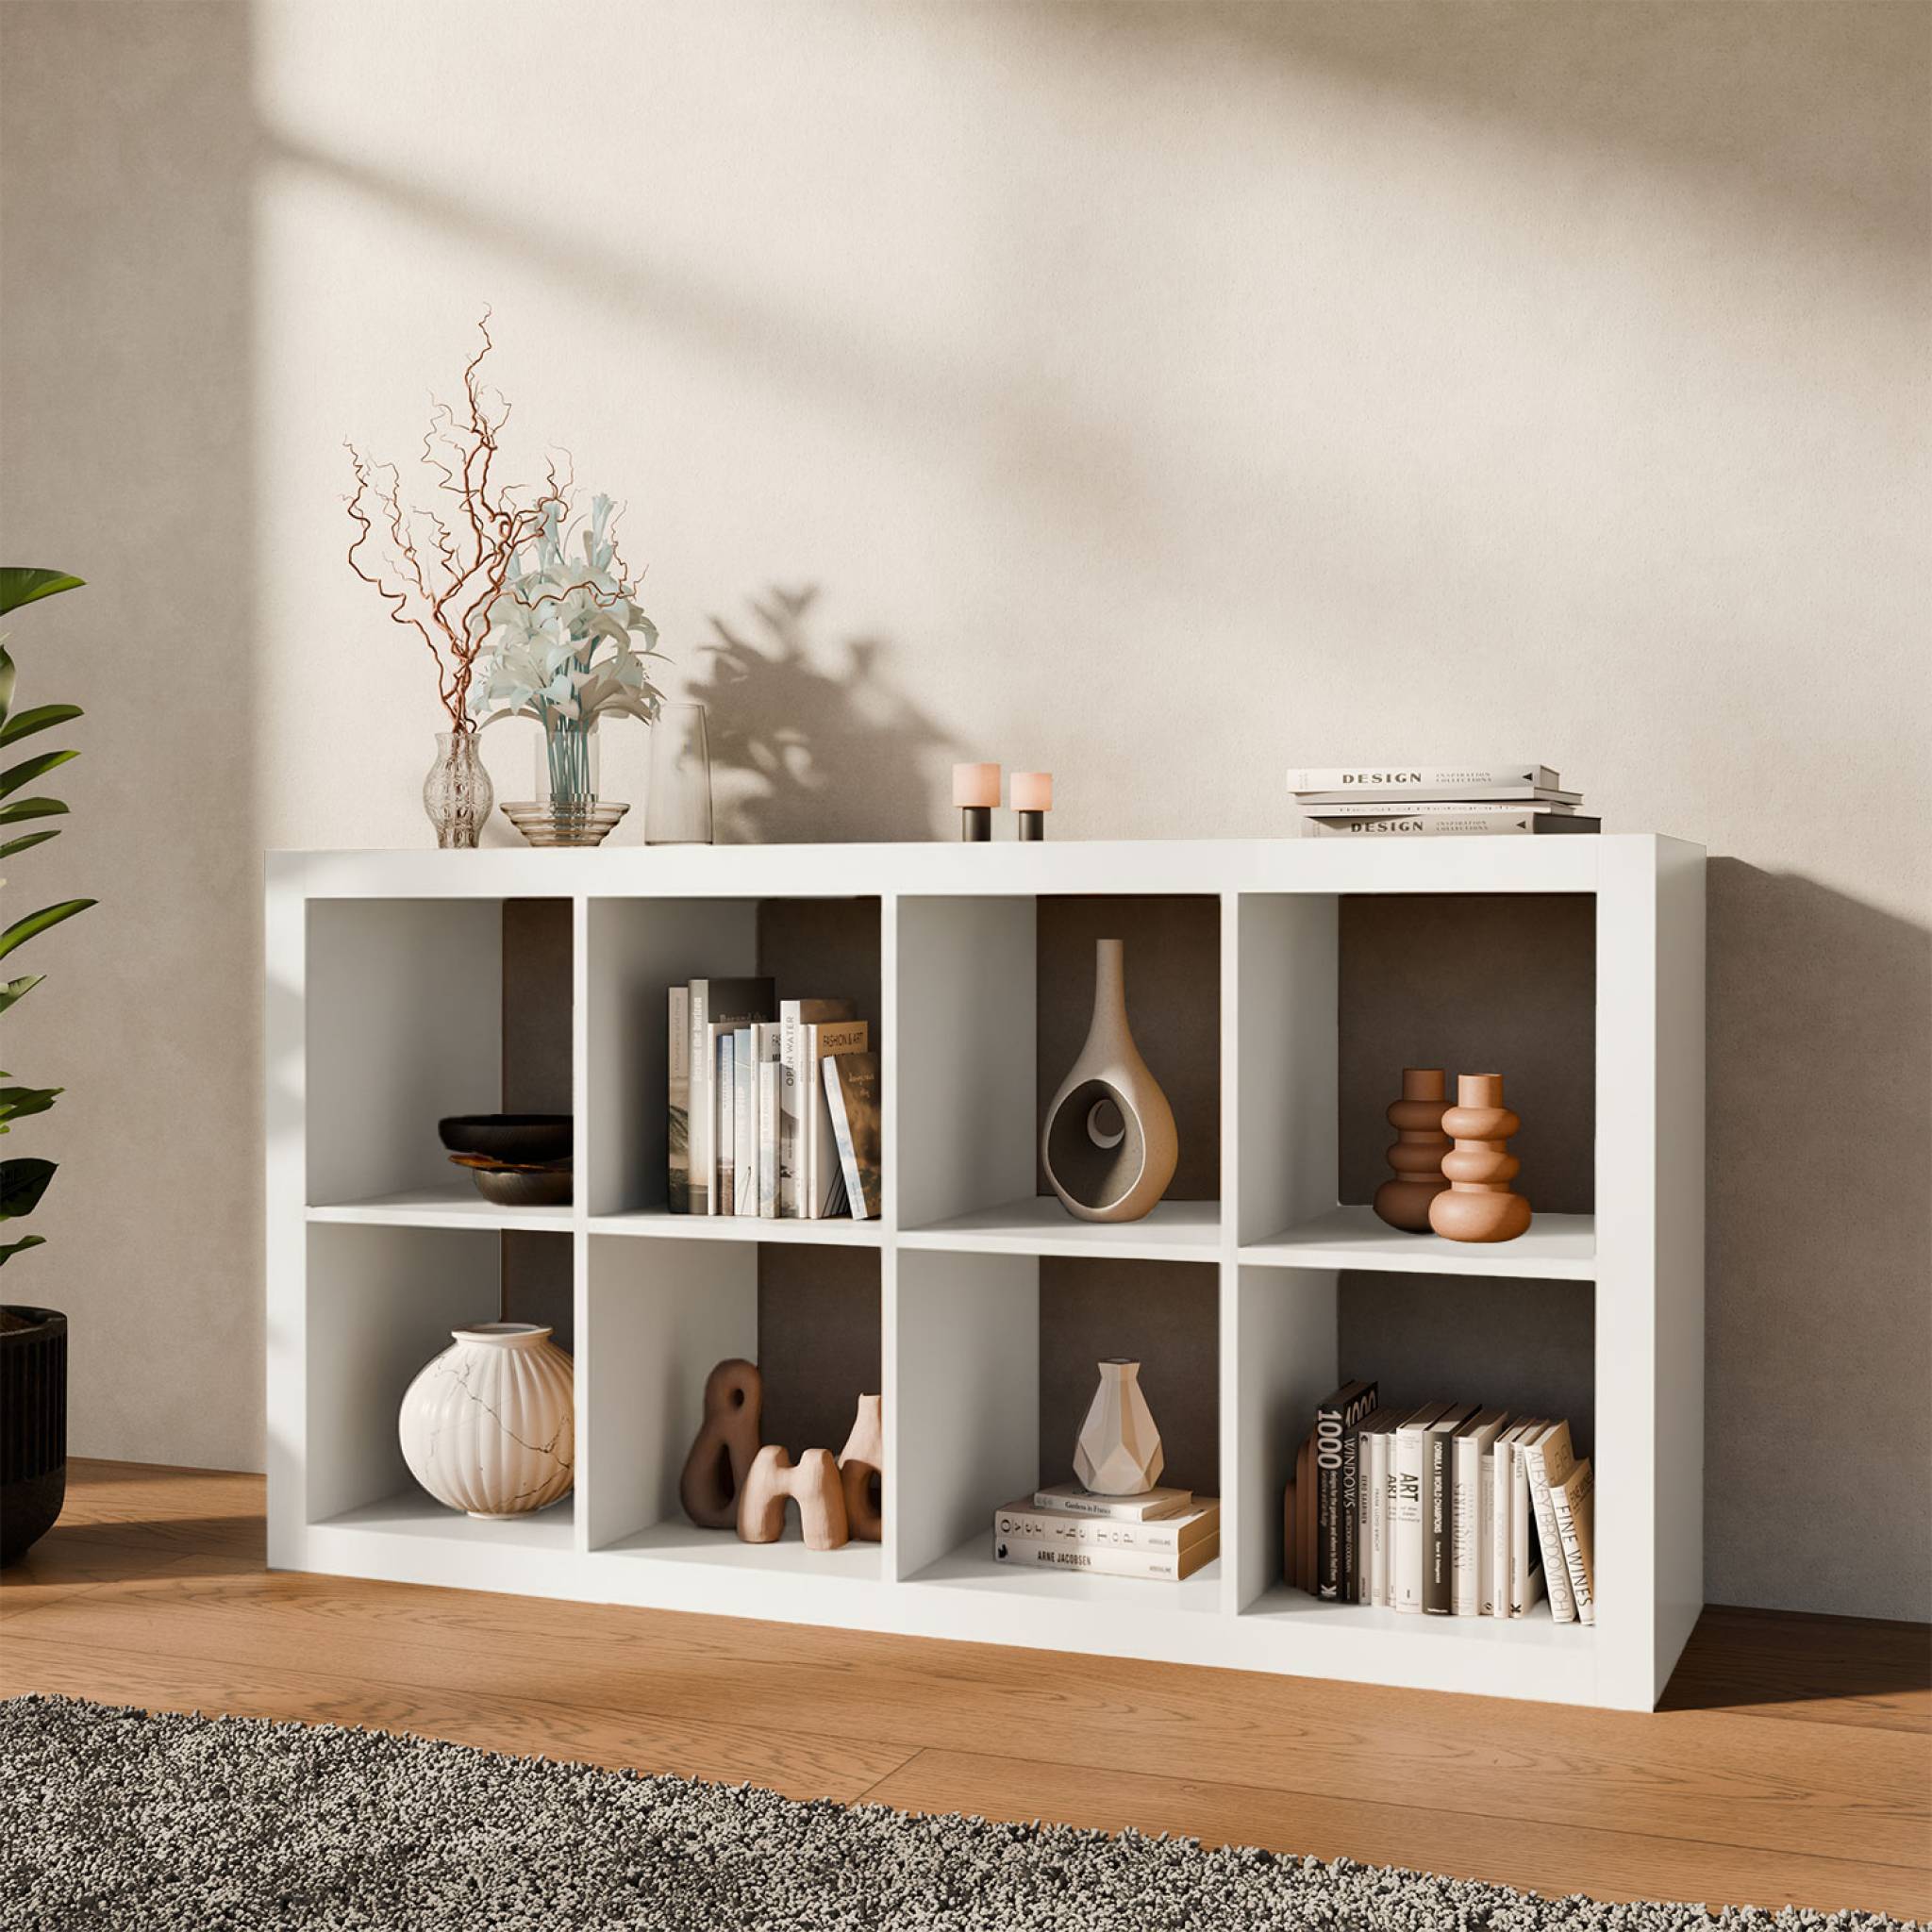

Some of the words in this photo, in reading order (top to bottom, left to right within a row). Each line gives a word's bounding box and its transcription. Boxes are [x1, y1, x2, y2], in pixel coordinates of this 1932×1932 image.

[1342, 773, 1422, 784] DESIGN
[1351, 821, 1424, 833] DESIGN
[785, 1016, 794, 1052] WATER
[785, 1057, 794, 1087] OPEN
[1318, 1410, 1342, 1469] 1000
[1434, 1441, 1442, 1471] FORMULA
[1343, 1438, 1356, 1507] WINDOWS
[1400, 1473, 1419, 1502] ART
[1434, 1475, 1442, 1497] WORLD
[1434, 1497, 1442, 1534] CHAMPIONS
[1528, 1451, 1552, 1510] ALEXEY
[1540, 1513, 1569, 1611] BRODOVITCH
[1038, 1550, 1055, 1563] ARNE
[1057, 1552, 1091, 1566] JACOBSEN
[1556, 1505, 1576, 1542] FINE
[1567, 1549, 1592, 1607] WINES
